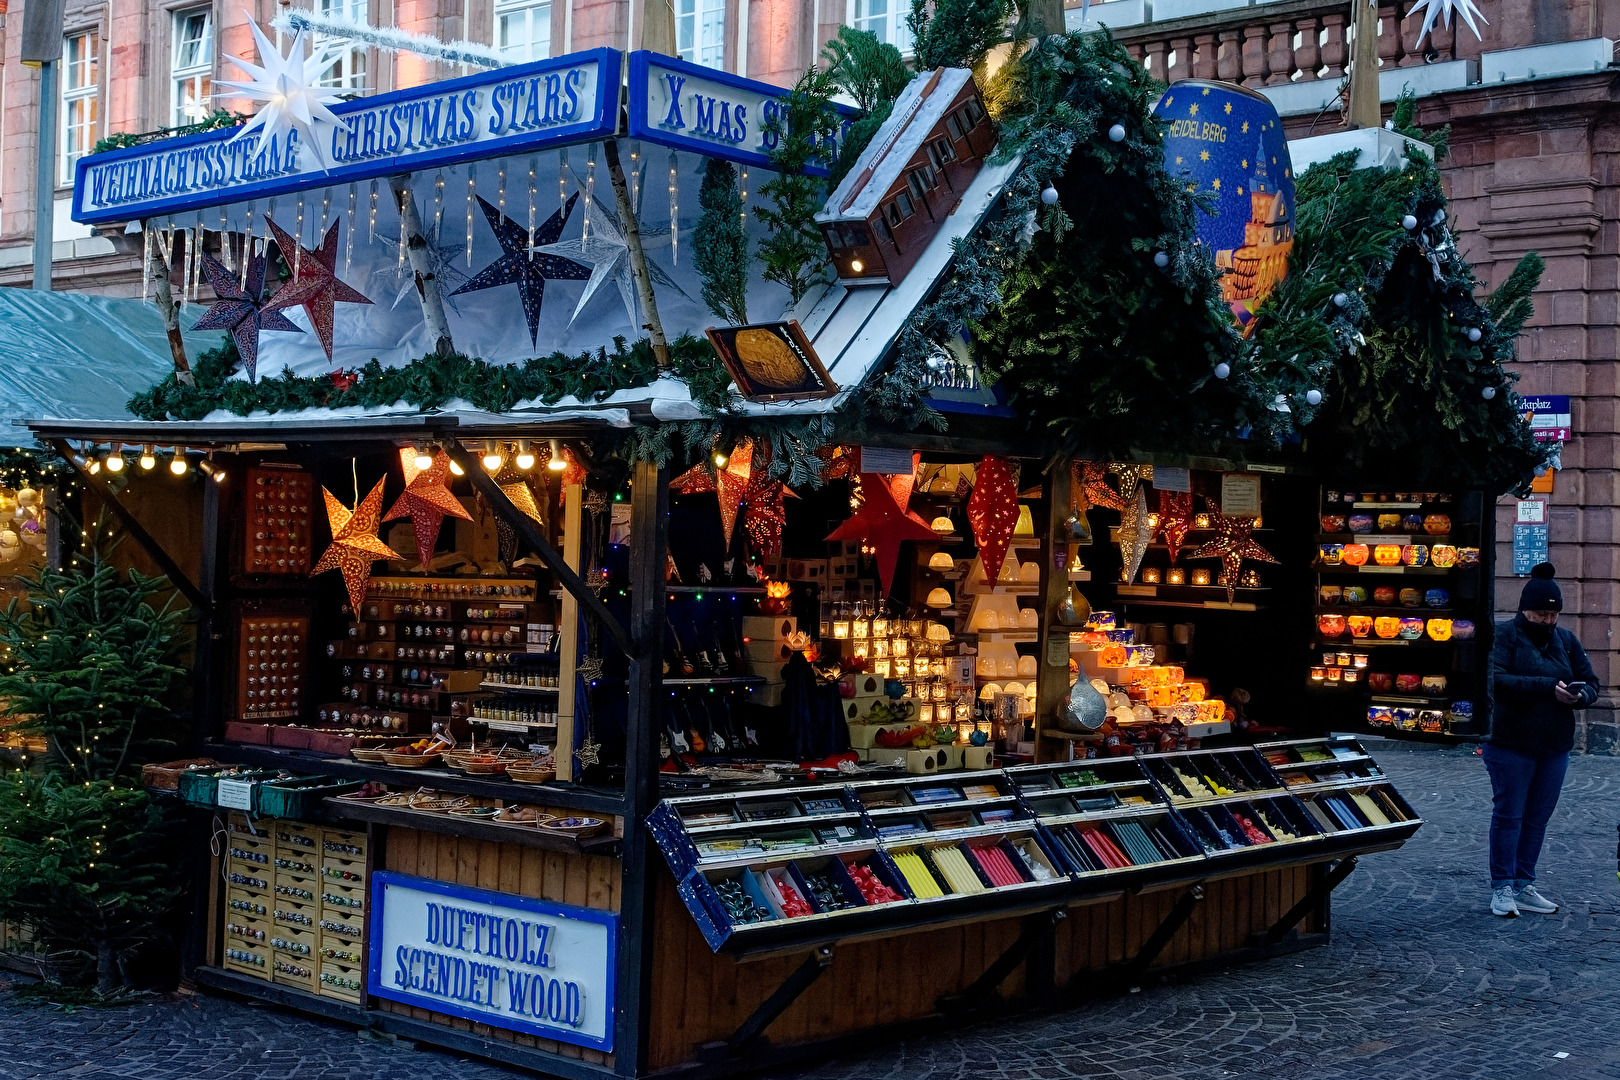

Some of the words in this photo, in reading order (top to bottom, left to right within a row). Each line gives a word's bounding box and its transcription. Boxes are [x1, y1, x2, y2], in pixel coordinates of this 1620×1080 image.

[91, 128, 299, 205] WEIHNACHTSSTERNE
[331, 90, 480, 162] CHRISTMAS
[489, 69, 584, 135] STARS
[663, 73, 686, 129] X
[692, 93, 747, 143] MAS
[1168, 119, 1227, 143] HEIDELBERG
[425, 902, 552, 968] DUFTHOLZ
[394, 944, 501, 1008] SCENDET
[506, 968, 584, 1027] WOOD
